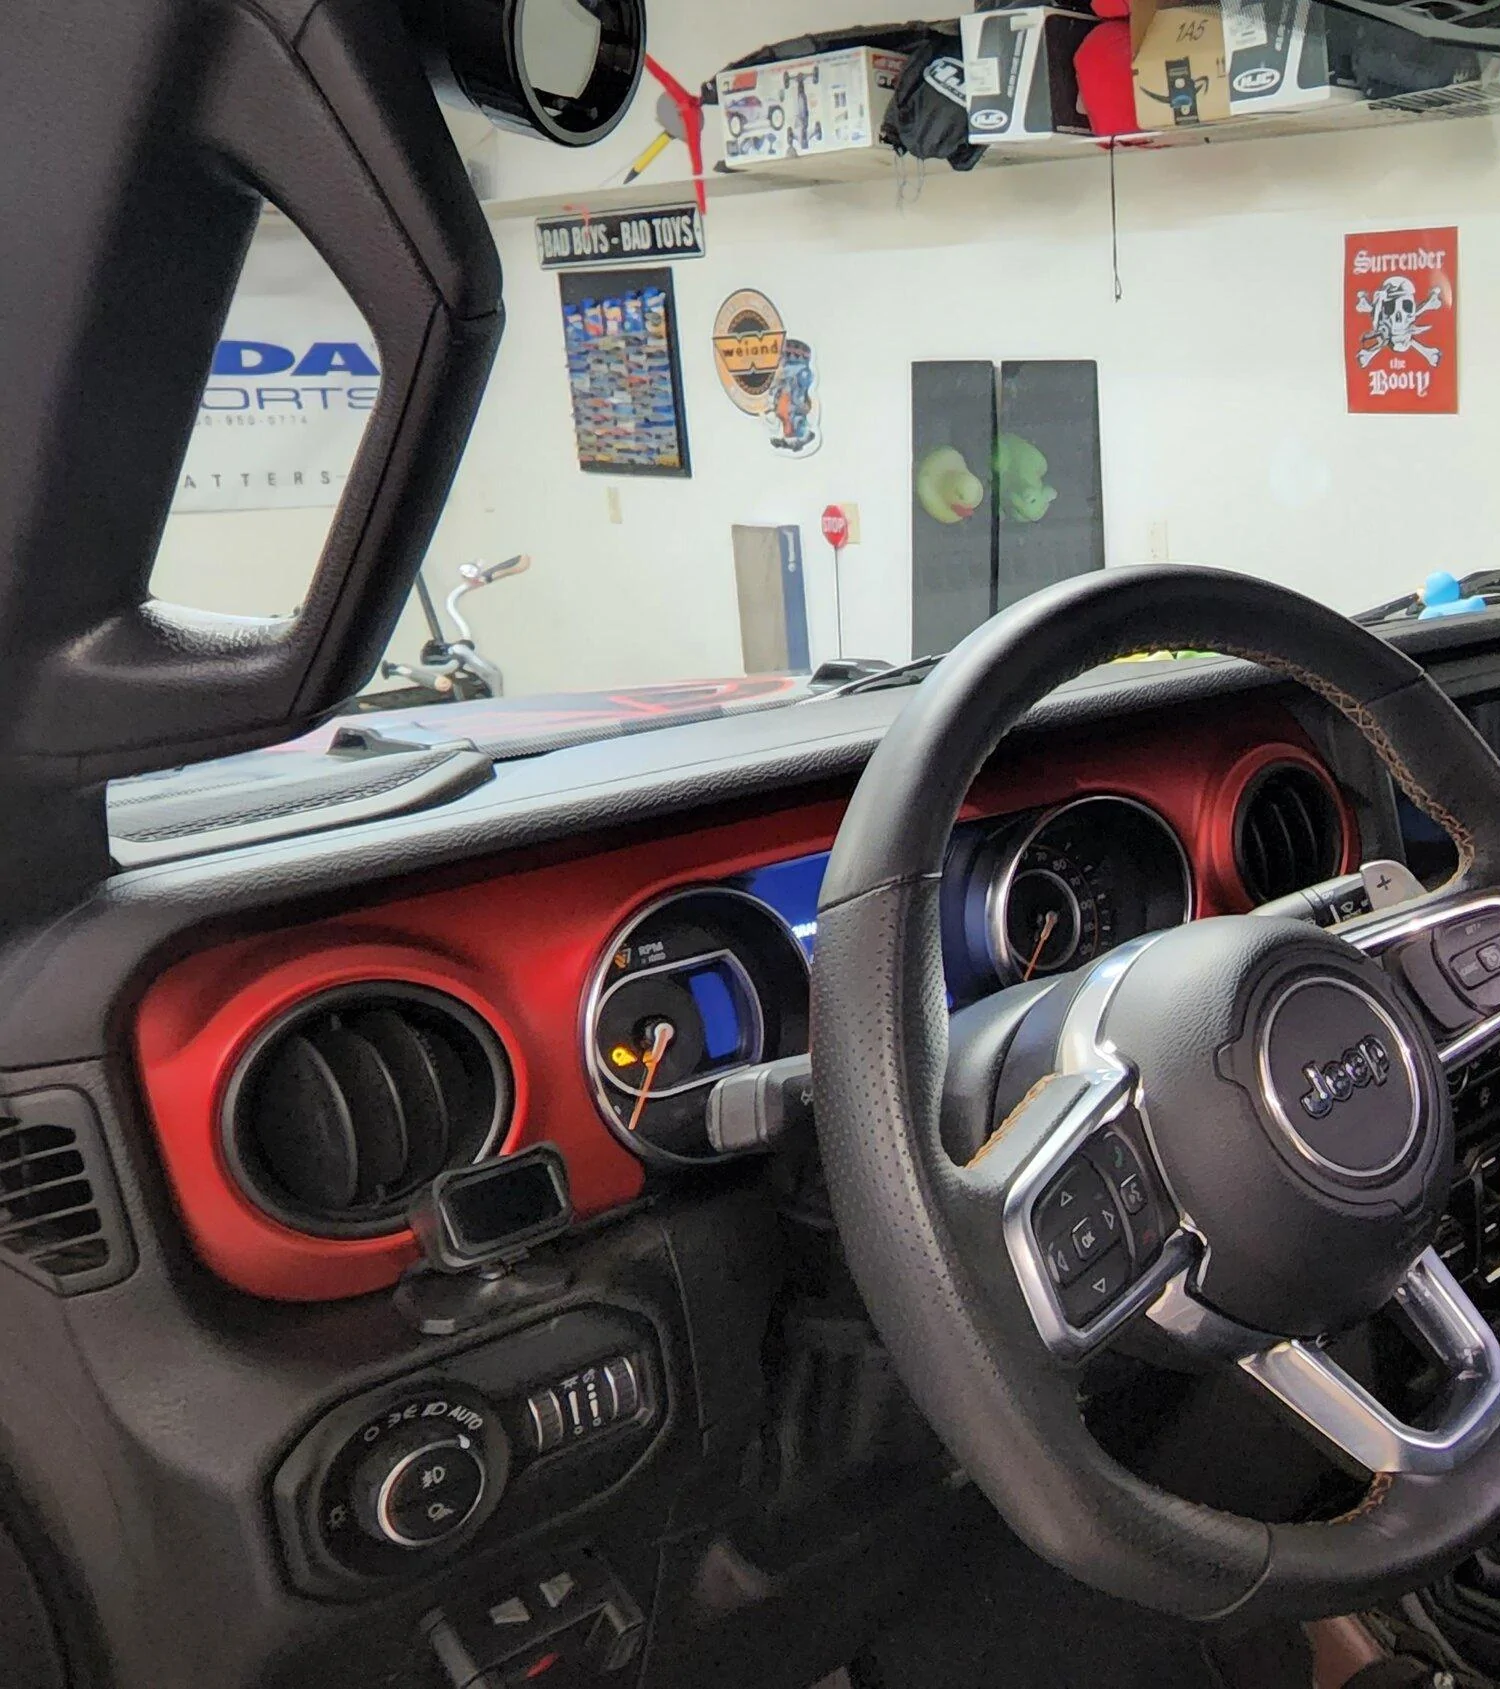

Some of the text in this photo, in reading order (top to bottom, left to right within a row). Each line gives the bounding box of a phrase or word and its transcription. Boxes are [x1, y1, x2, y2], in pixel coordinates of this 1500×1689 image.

[542, 227, 570, 258] BAD
[571, 223, 610, 256] BOYS
[620, 218, 652, 252] BAD
[651, 214, 694, 249] TOYS
[1352, 248, 1446, 275] Surrender
[210, 340, 382, 377] DA
[1389, 357, 1406, 370] the
[1368, 369, 1431, 397] Booty
[200, 386, 379, 411] ORTS
[184, 471, 331, 489] ATTERS
[822, 516, 846, 533] STOP
[1300, 1034, 1390, 1120] Jeep
[447, 1404, 484, 1431] AUTO
